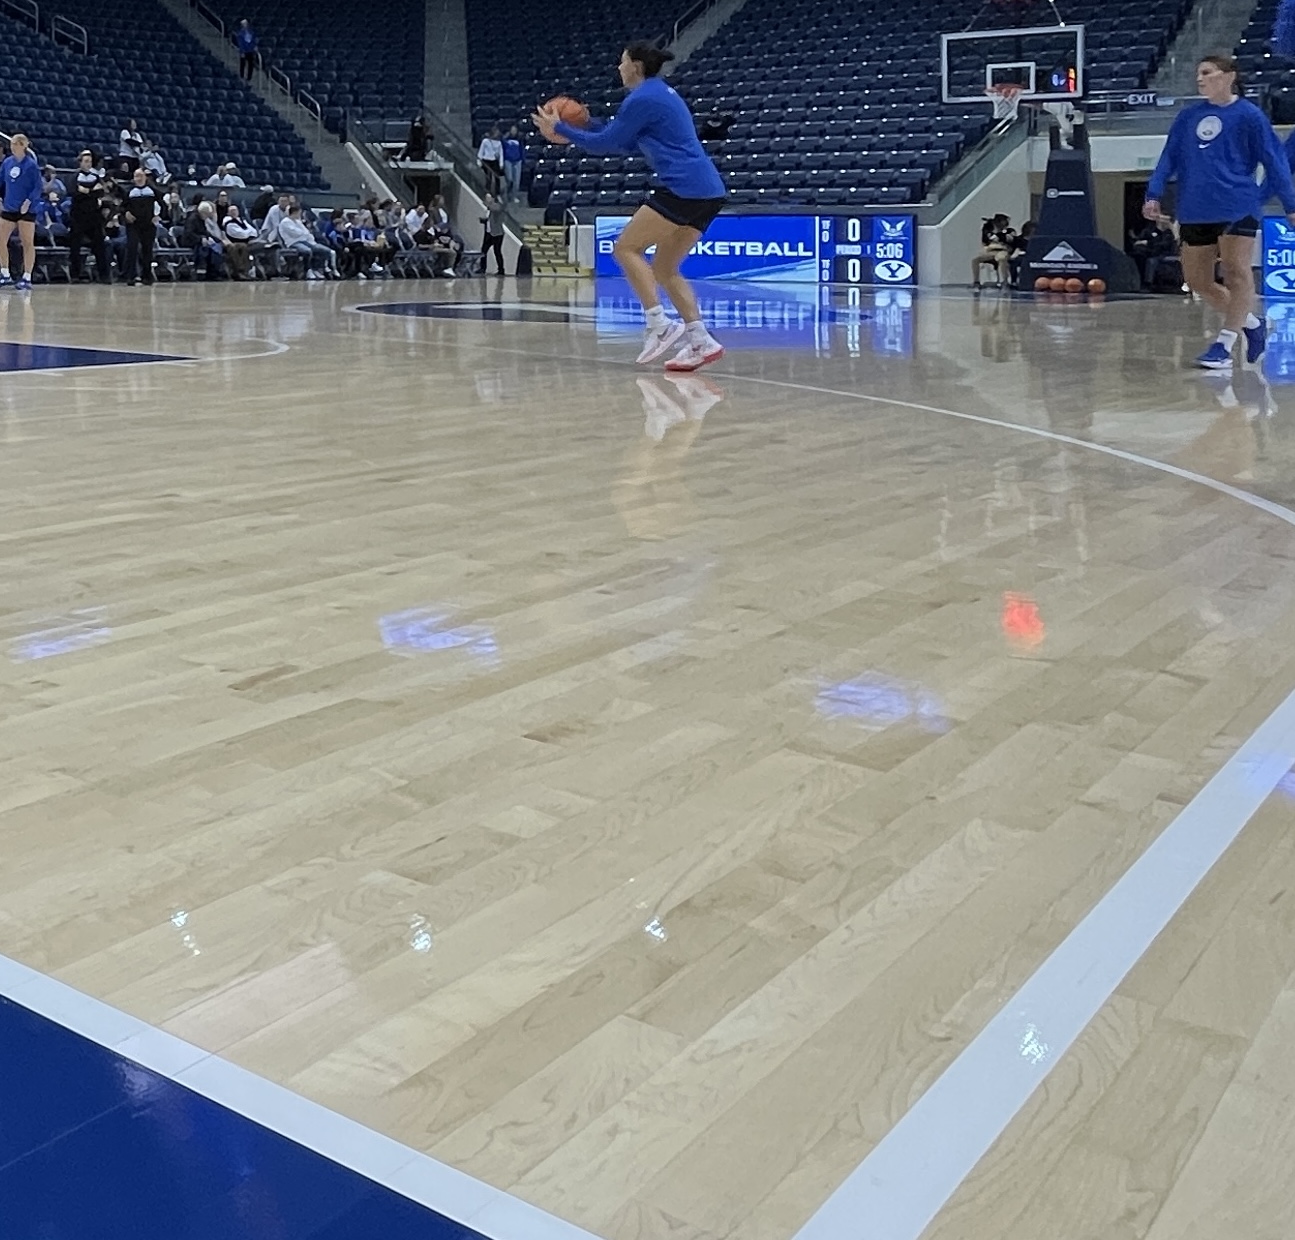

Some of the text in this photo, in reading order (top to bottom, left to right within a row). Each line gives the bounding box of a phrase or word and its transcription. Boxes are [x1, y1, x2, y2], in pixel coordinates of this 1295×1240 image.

[1128, 93, 1156, 105] EXIT
[847, 218, 861, 242] 0
[875, 242, 904, 259] 5:06
[1267, 249, 1295, 267] 5:0
[847, 258, 861, 282] 0
